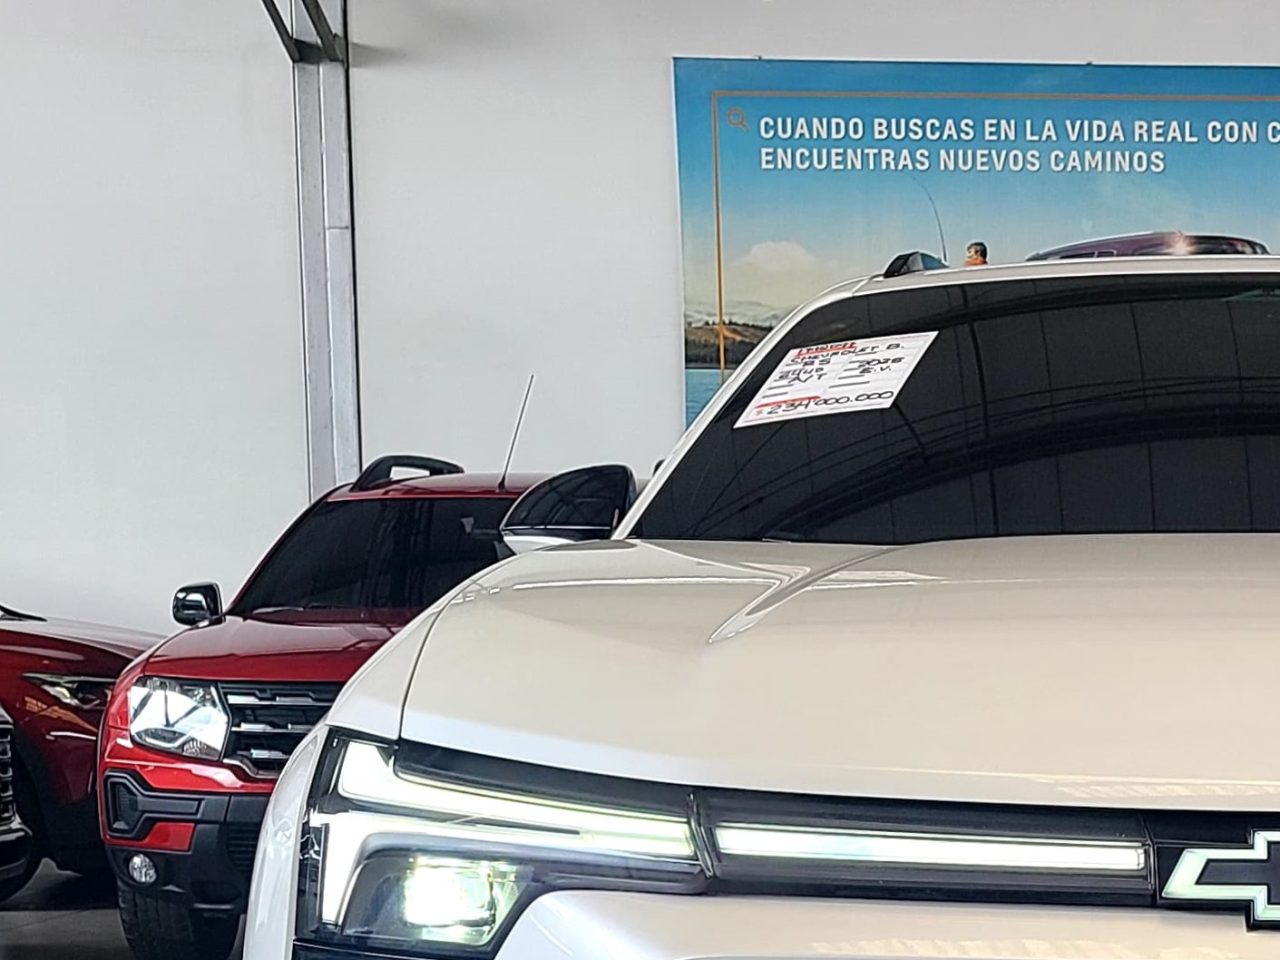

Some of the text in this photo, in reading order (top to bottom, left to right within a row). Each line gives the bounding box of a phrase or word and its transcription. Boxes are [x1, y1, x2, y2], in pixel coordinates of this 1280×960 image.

[759, 117, 864, 139] CUANDO
[873, 118, 974, 141] BUSCAS
[984, 119, 1016, 141] EN
[1025, 119, 1057, 142] LA
[1065, 120, 1125, 142] VIDA
[1134, 121, 1198, 143] REAL
[1206, 121, 1257, 144] CON
[760, 147, 1165, 173] ENCUENTRAS NUEVOS CAMINOS
